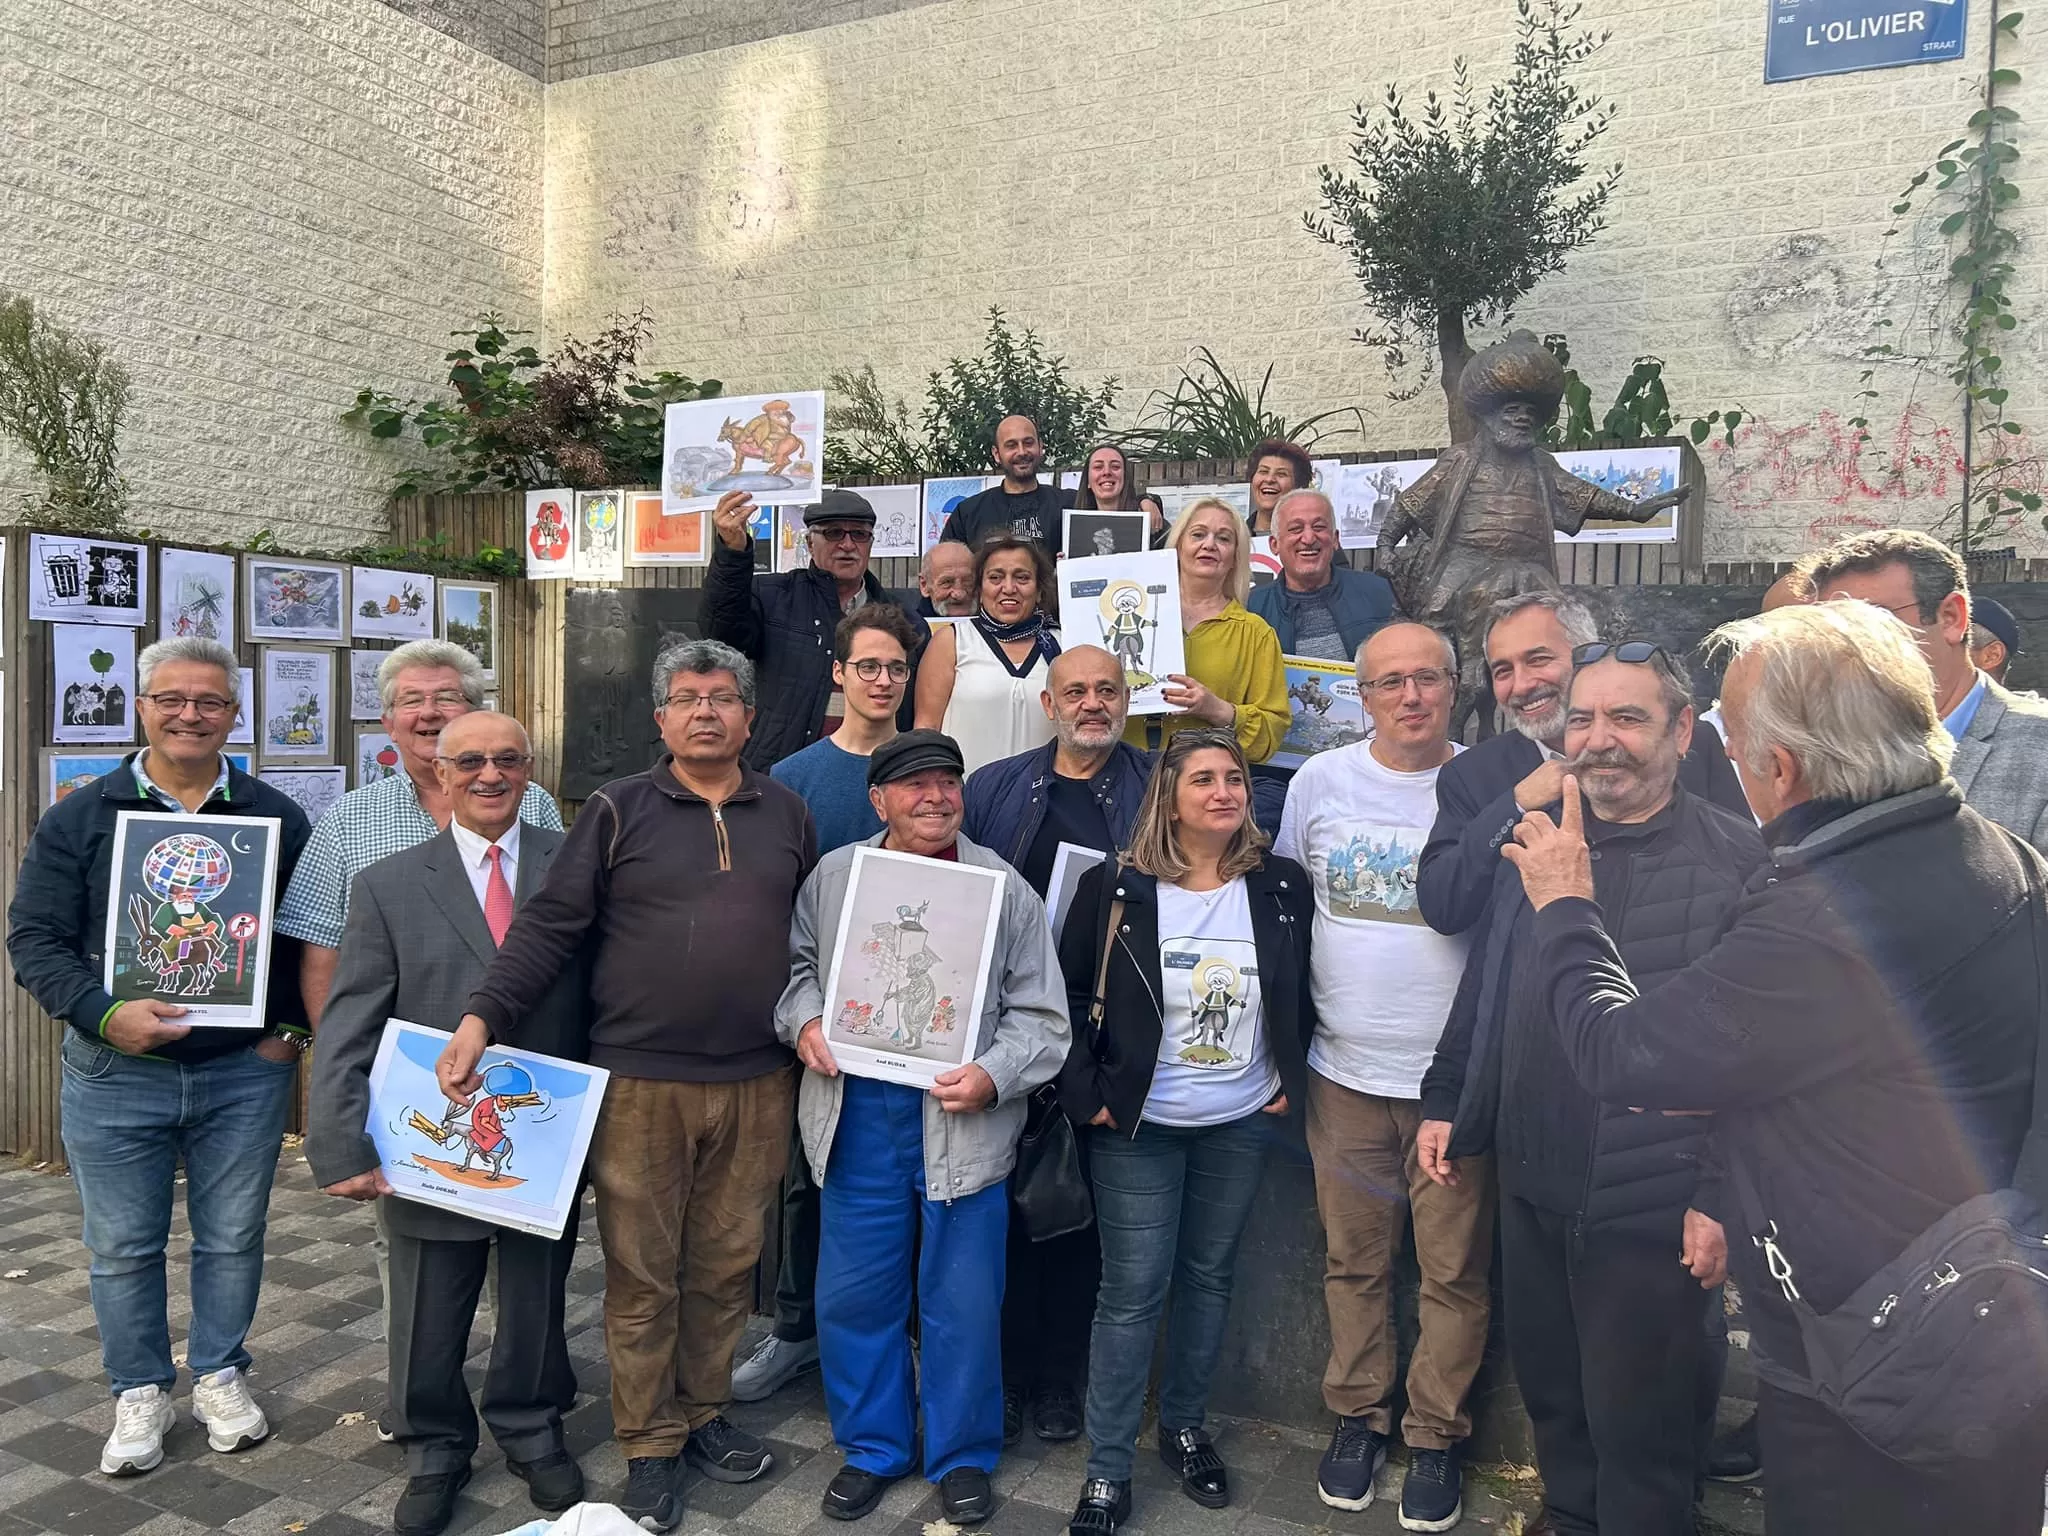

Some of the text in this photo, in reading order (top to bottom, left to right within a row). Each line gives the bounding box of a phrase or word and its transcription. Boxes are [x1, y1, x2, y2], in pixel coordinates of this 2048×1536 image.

[1778, 14, 1797, 25] RUE
[1805, 10, 1926, 46] L'OLIVIER
[1922, 40, 1957, 52] STRAAT
